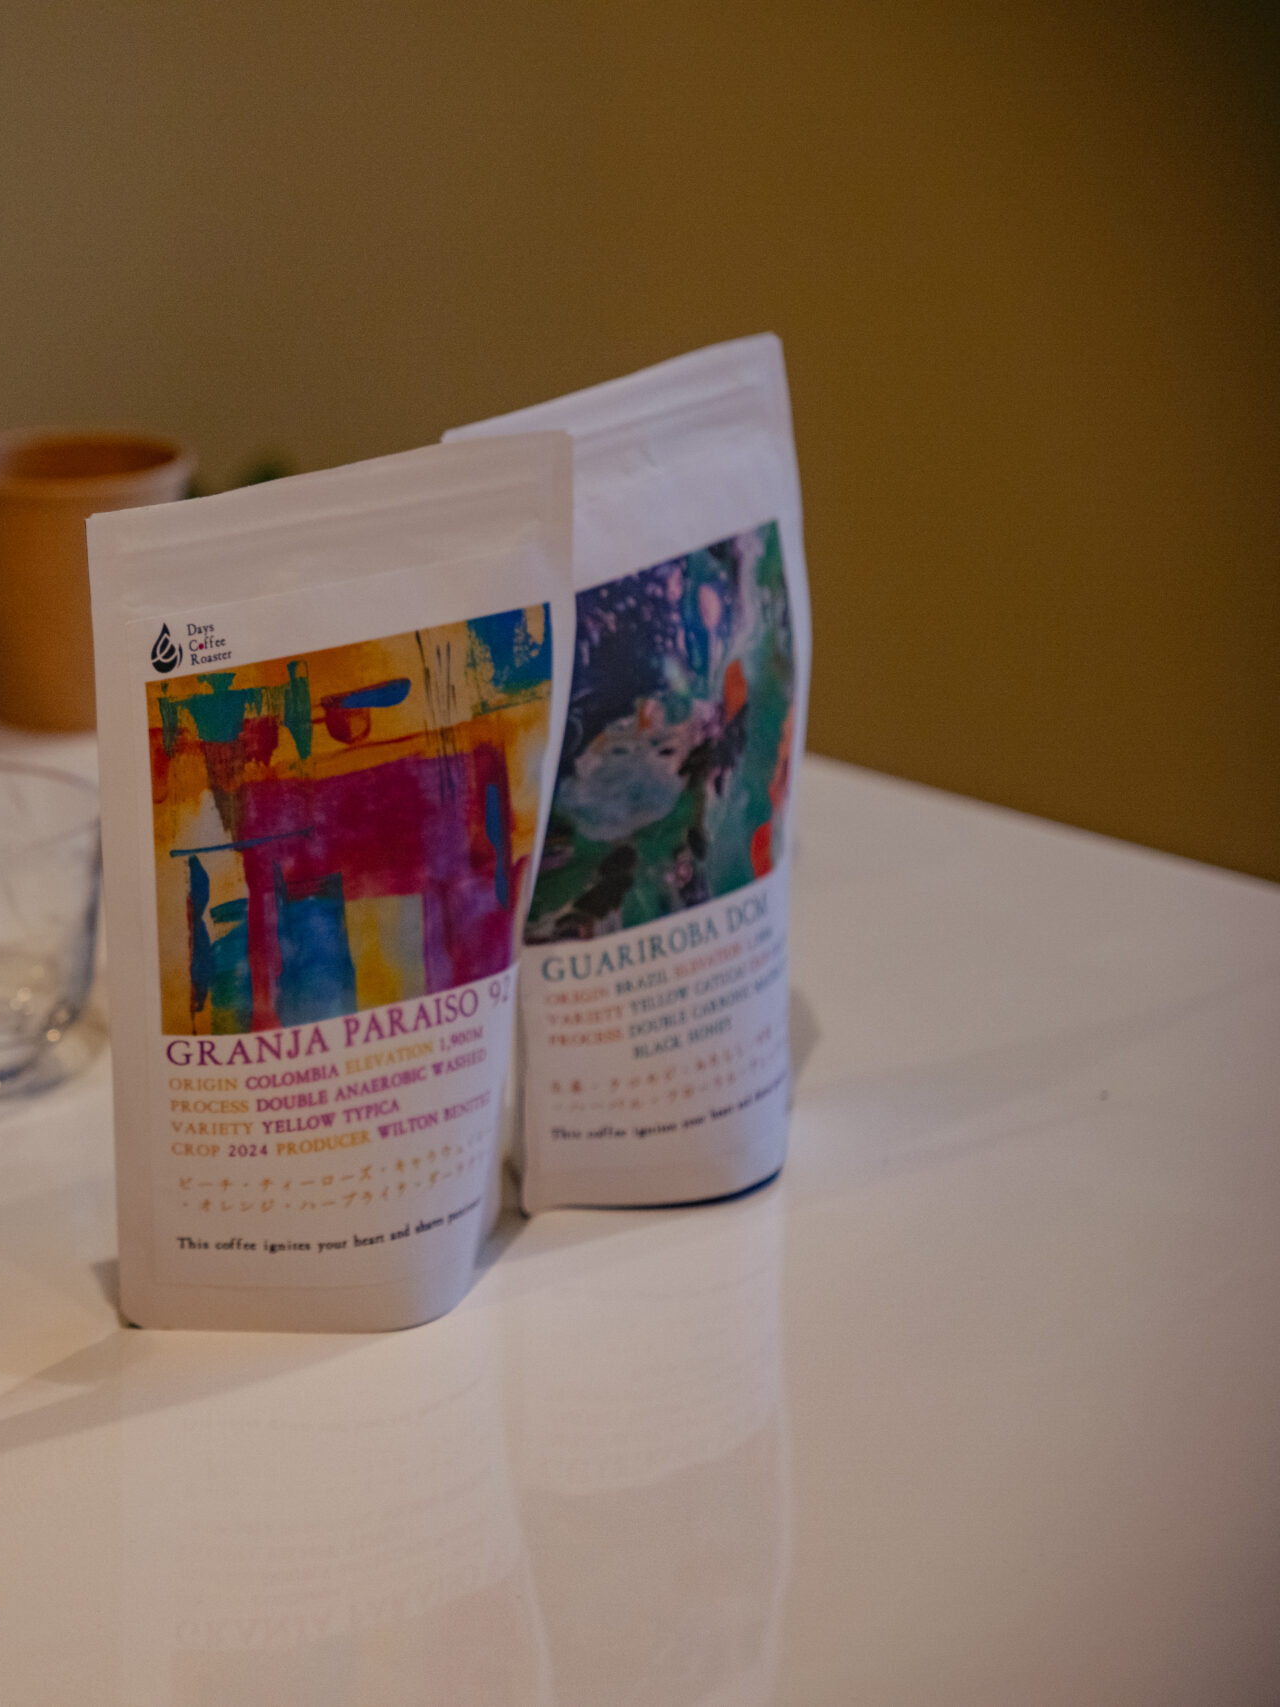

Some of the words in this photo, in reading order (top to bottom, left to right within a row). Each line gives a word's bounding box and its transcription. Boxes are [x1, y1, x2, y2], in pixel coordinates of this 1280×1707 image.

[187, 624, 215, 635] Days
[189, 636, 226, 651] Coffee
[191, 651, 232, 665] Roaster
[166, 1023, 330, 1068] GRANJA
[343, 987, 479, 1048] PARAISO
[169, 1077, 238, 1091] ORIGIN
[245, 1063, 338, 1090] COLOMBIA
[345, 1040, 434, 1075] ELEVATION
[171, 1098, 249, 1113] PROCESS
[256, 1090, 327, 1111] DOUBLE
[335, 1066, 426, 1101] ANAEROBIC
[170, 1122, 253, 1133] VARIETY
[263, 1112, 334, 1134] YELLOW
[342, 1097, 400, 1124] TYPICA
[171, 1143, 219, 1156] CROP
[228, 1143, 267, 1158] 2024
[276, 1130, 370, 1156] PRODUCER
[377, 1111, 438, 1140] WILTON
[177, 1237, 209, 1251] This
[215, 1238, 256, 1251] coffee
[264, 1241, 311, 1254] ignites
[318, 1239, 347, 1253] your
[390, 1224, 410, 1241] and
